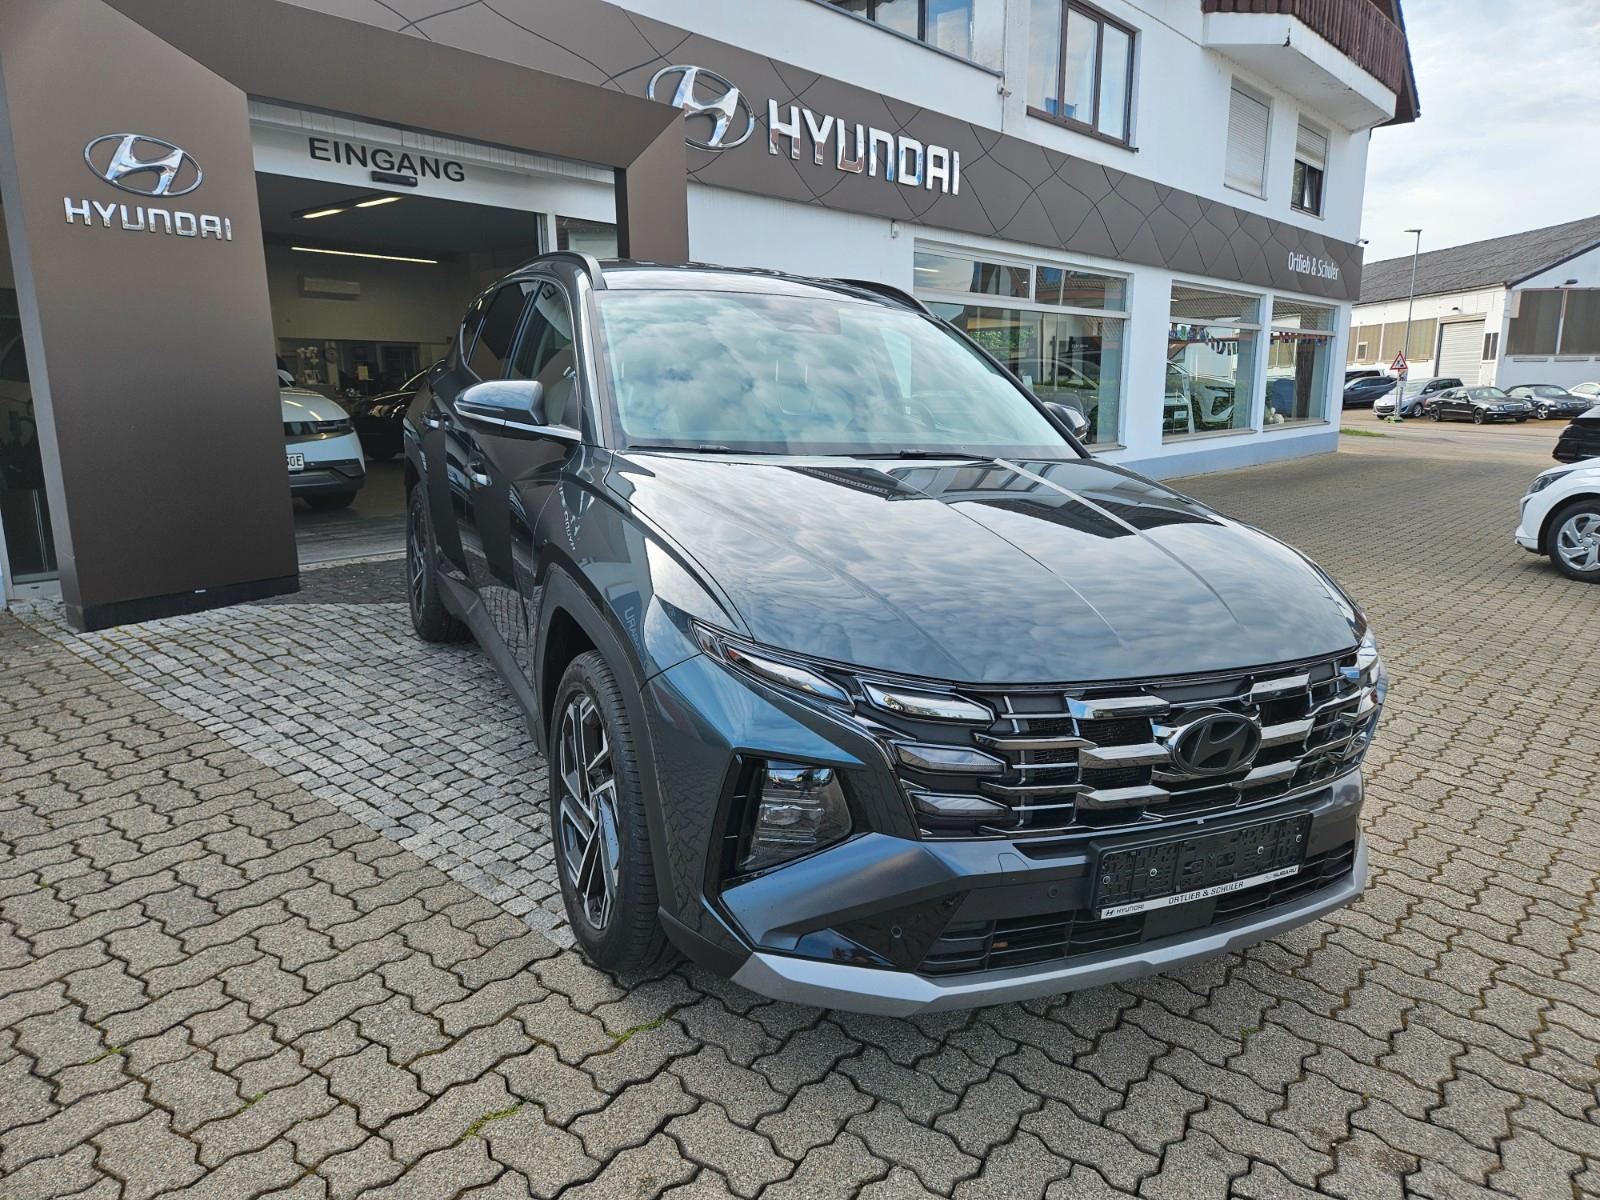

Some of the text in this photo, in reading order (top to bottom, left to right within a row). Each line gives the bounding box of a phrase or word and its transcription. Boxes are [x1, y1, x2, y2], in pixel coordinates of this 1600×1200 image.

[308, 137, 465, 183] EINGANG
[768, 98, 960, 196] HYUNDAI
[63, 196, 233, 241] HYUNDAI
[1288, 251, 1311, 275] Ortlieb
[1310, 257, 1317, 276] &
[1116, 903, 1145, 915] HYUNDAI
[1168, 891, 1201, 905] ORTLIEB
[1202, 889, 1209, 897] &
[1210, 881, 1244, 896] SCHULER
